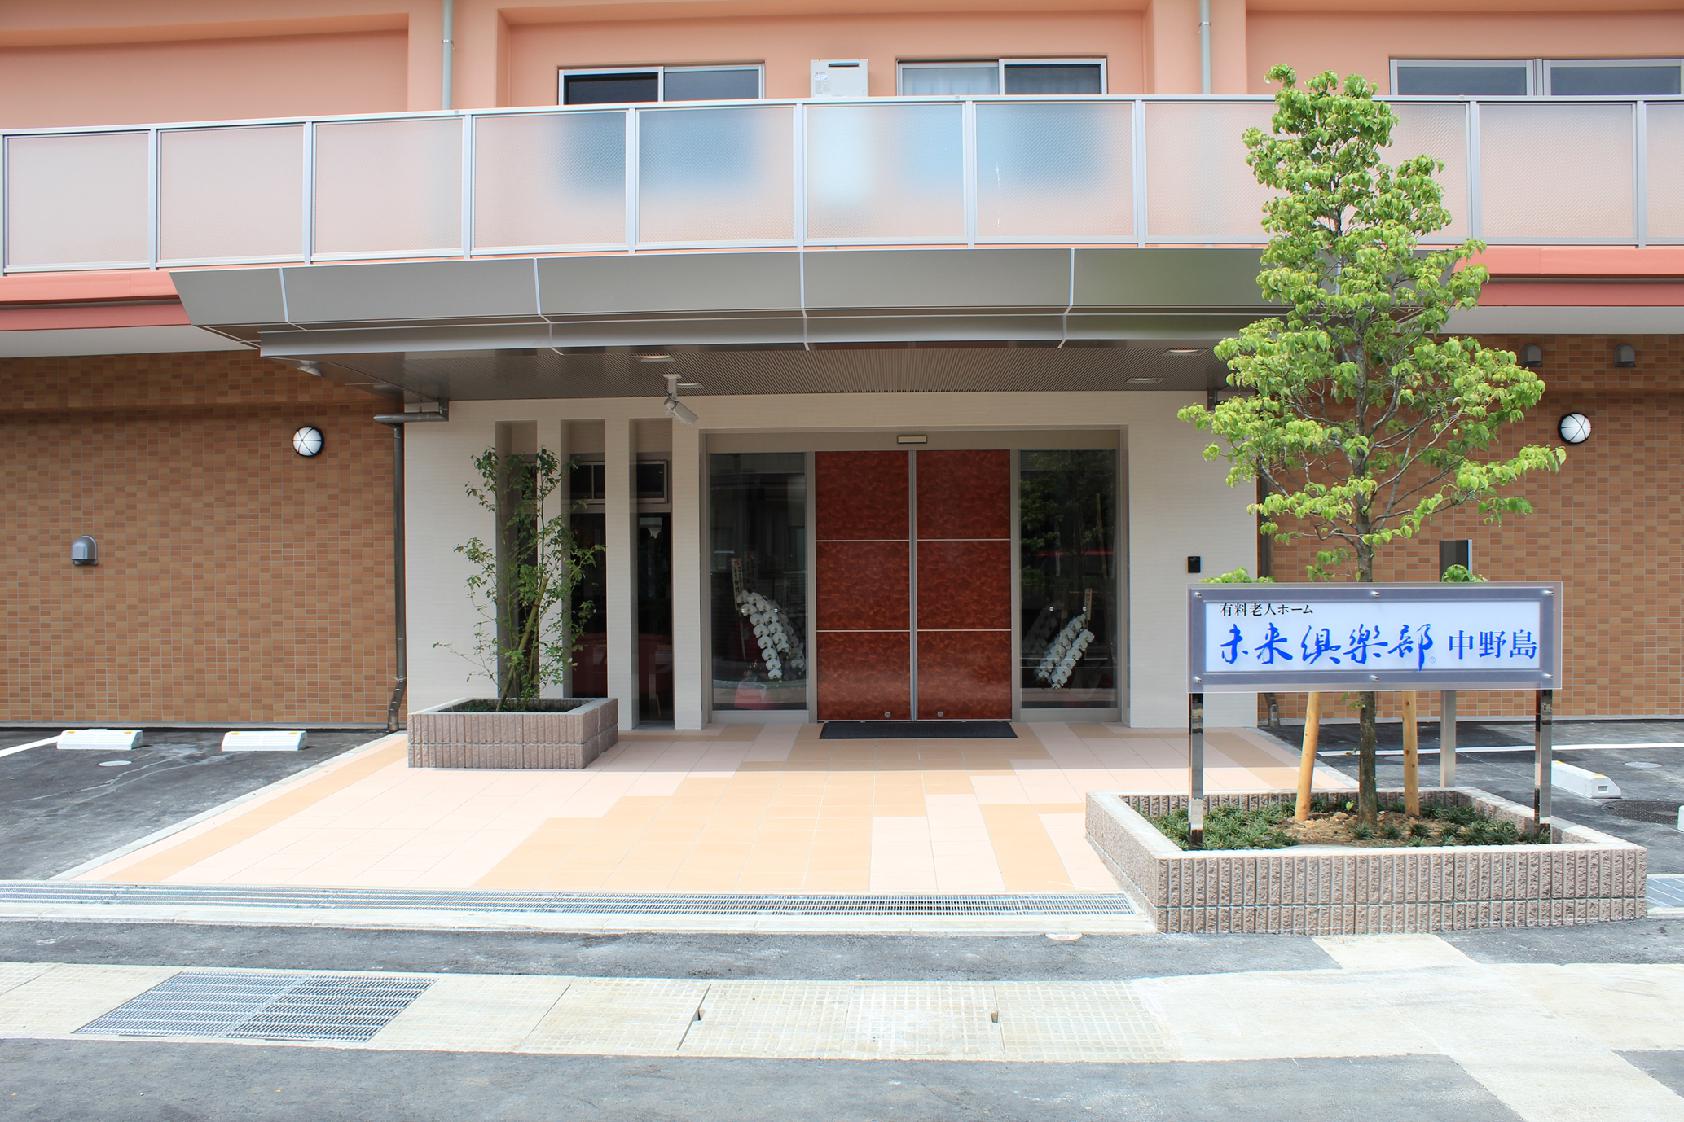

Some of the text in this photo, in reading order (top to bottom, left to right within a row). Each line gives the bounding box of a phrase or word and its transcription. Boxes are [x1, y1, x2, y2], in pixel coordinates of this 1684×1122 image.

[1220, 602, 1313, 617] 有料老人ホーム
[1448, 629, 1538, 660] 中野島
